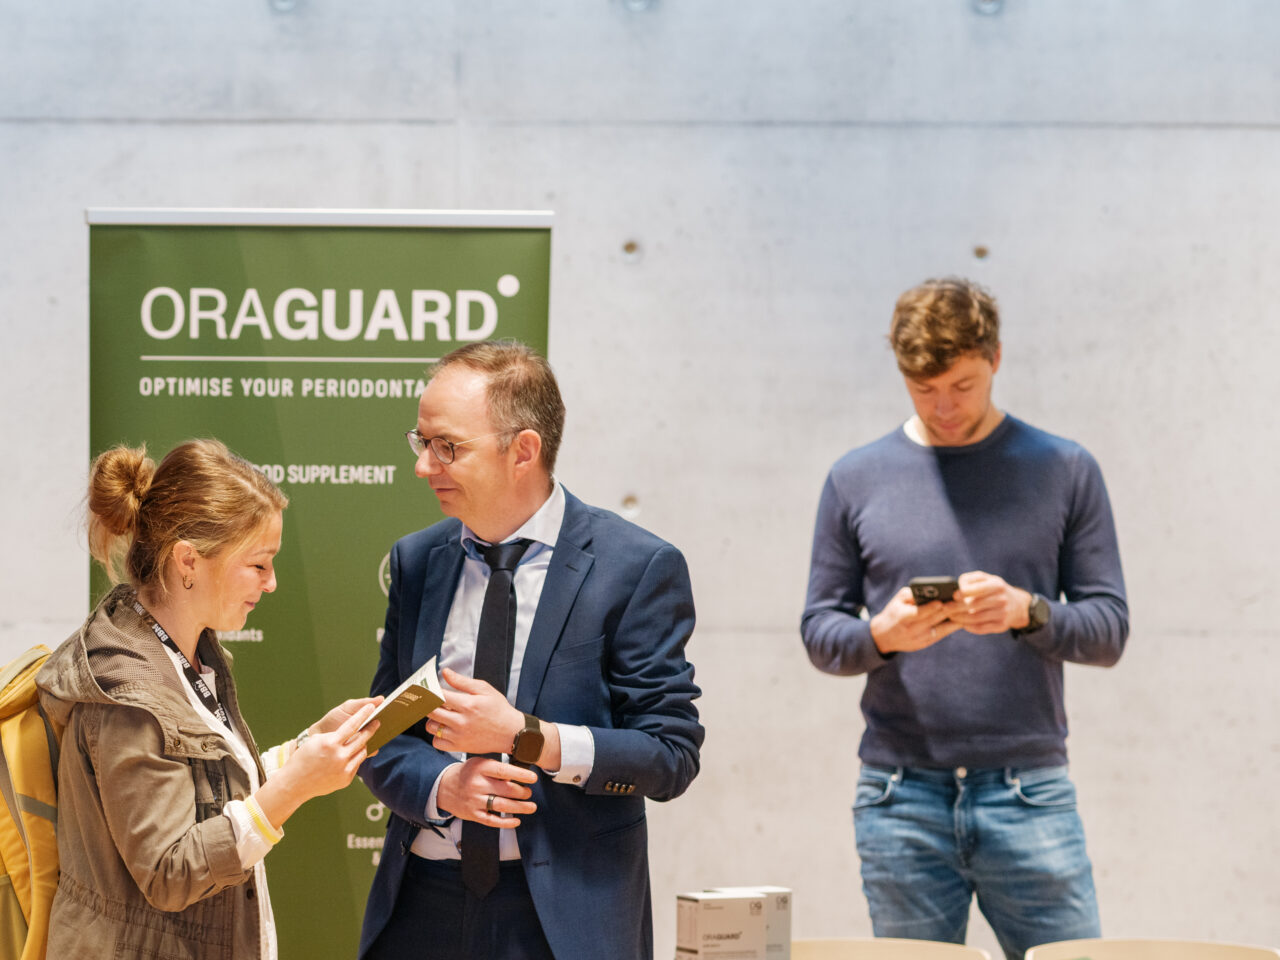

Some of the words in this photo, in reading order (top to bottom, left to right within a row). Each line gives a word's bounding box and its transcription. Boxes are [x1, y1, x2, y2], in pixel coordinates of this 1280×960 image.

[140, 286, 499, 342] ORAGUARD
[140, 377, 233, 397] OPTIMISE
[241, 378, 294, 397] YOUR
[302, 378, 424, 399] PERIODONTA
[287, 464, 396, 485] SUPPLEMENT
[152, 623, 169, 642] BBM
[175, 651, 191, 669] BBM
[195, 679, 212, 698] BBM
